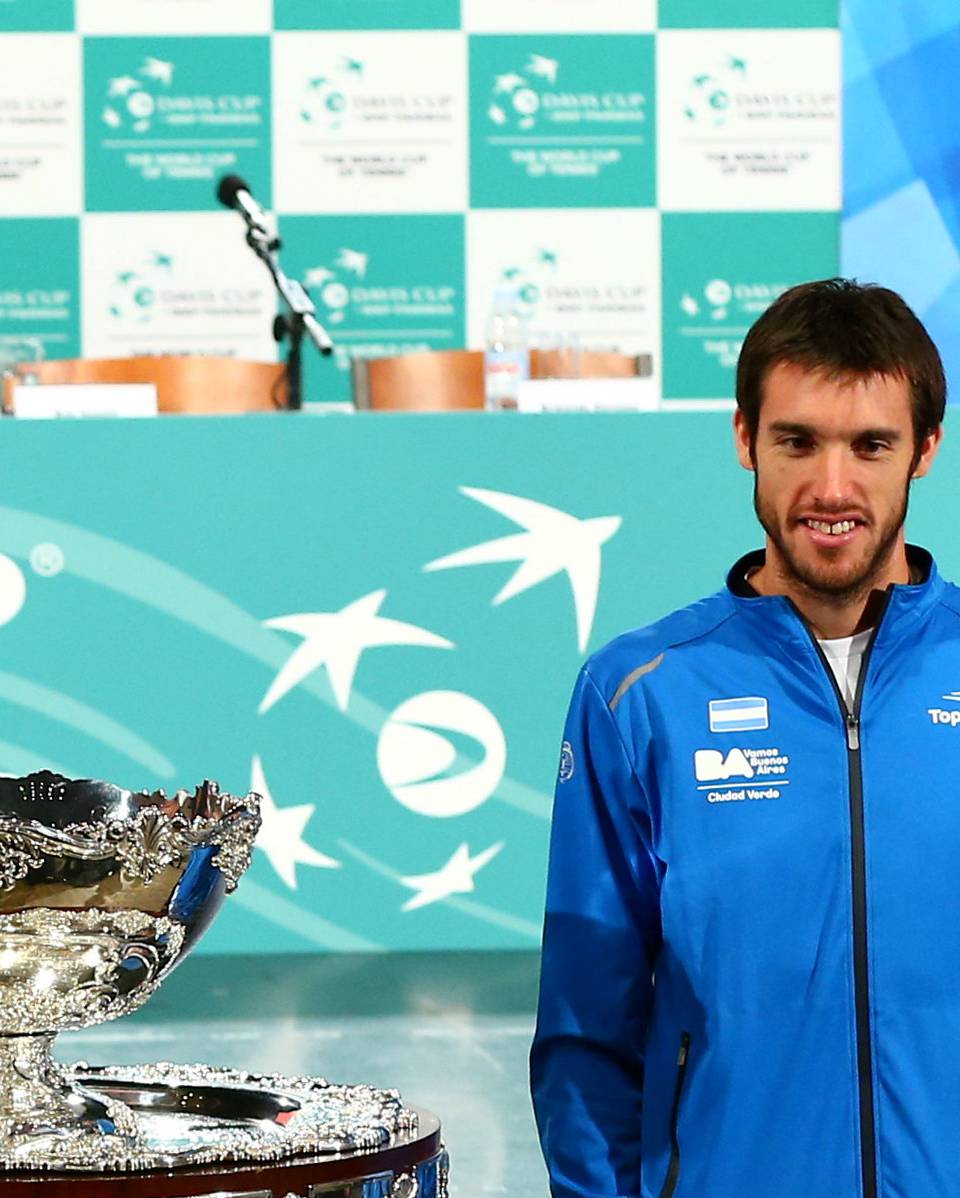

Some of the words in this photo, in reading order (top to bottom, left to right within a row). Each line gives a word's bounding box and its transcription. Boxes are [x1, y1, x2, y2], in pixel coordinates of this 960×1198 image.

[743, 748, 779, 758] Vamos
[750, 756, 789, 767] Buenos
[757, 765, 786, 775] Aires
[707, 791, 745, 803] Ciudad
[746, 788, 780, 800] Verde
